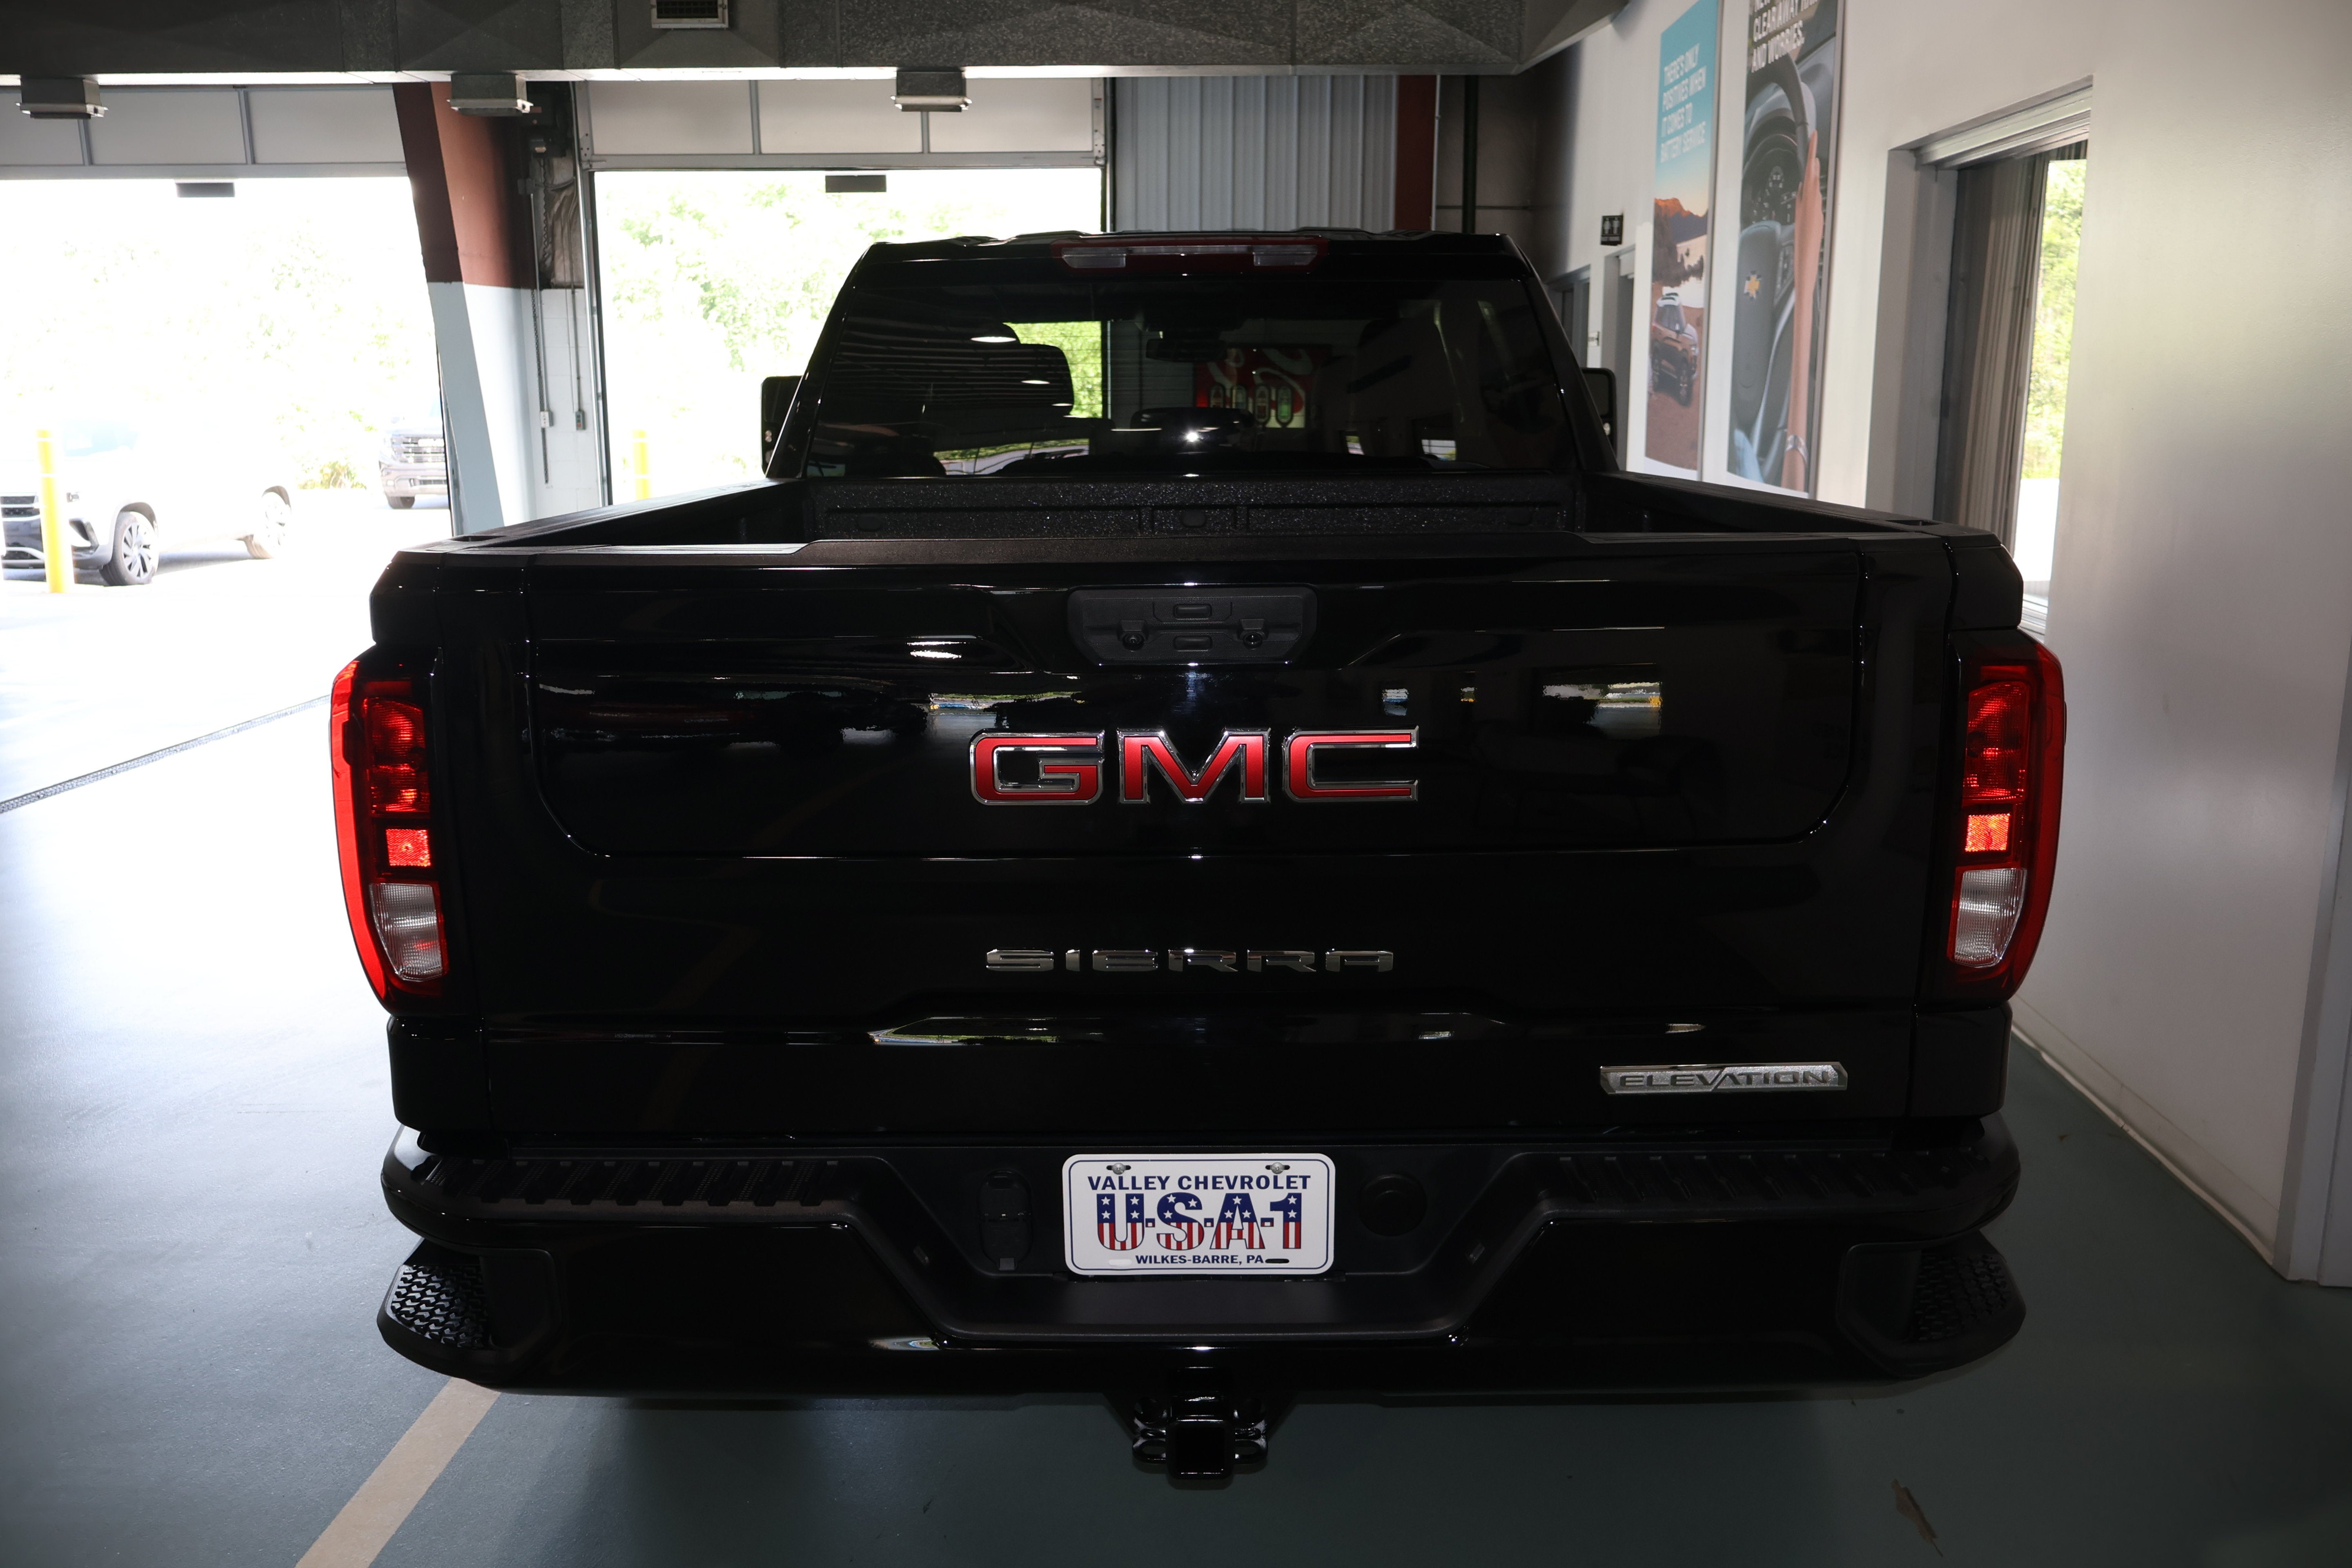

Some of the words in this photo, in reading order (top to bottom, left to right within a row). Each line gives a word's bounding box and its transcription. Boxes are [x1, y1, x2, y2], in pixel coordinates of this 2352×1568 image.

[1753, 6, 1777, 42] CLEAR
[1751, 43, 1767, 73] AND
[969, 725, 1419, 804] GMC
[986, 949, 1394, 973] SIERRA
[1619, 1070, 1829, 1088] ELEVATION
[1087, 1176, 1170, 1190] VALLEY
[1178, 1175, 1311, 1190] CHEVROLET
[1135, 1255, 1242, 1265] WILKES-BARRE,
[1247, 1255, 1264, 1263] PA
